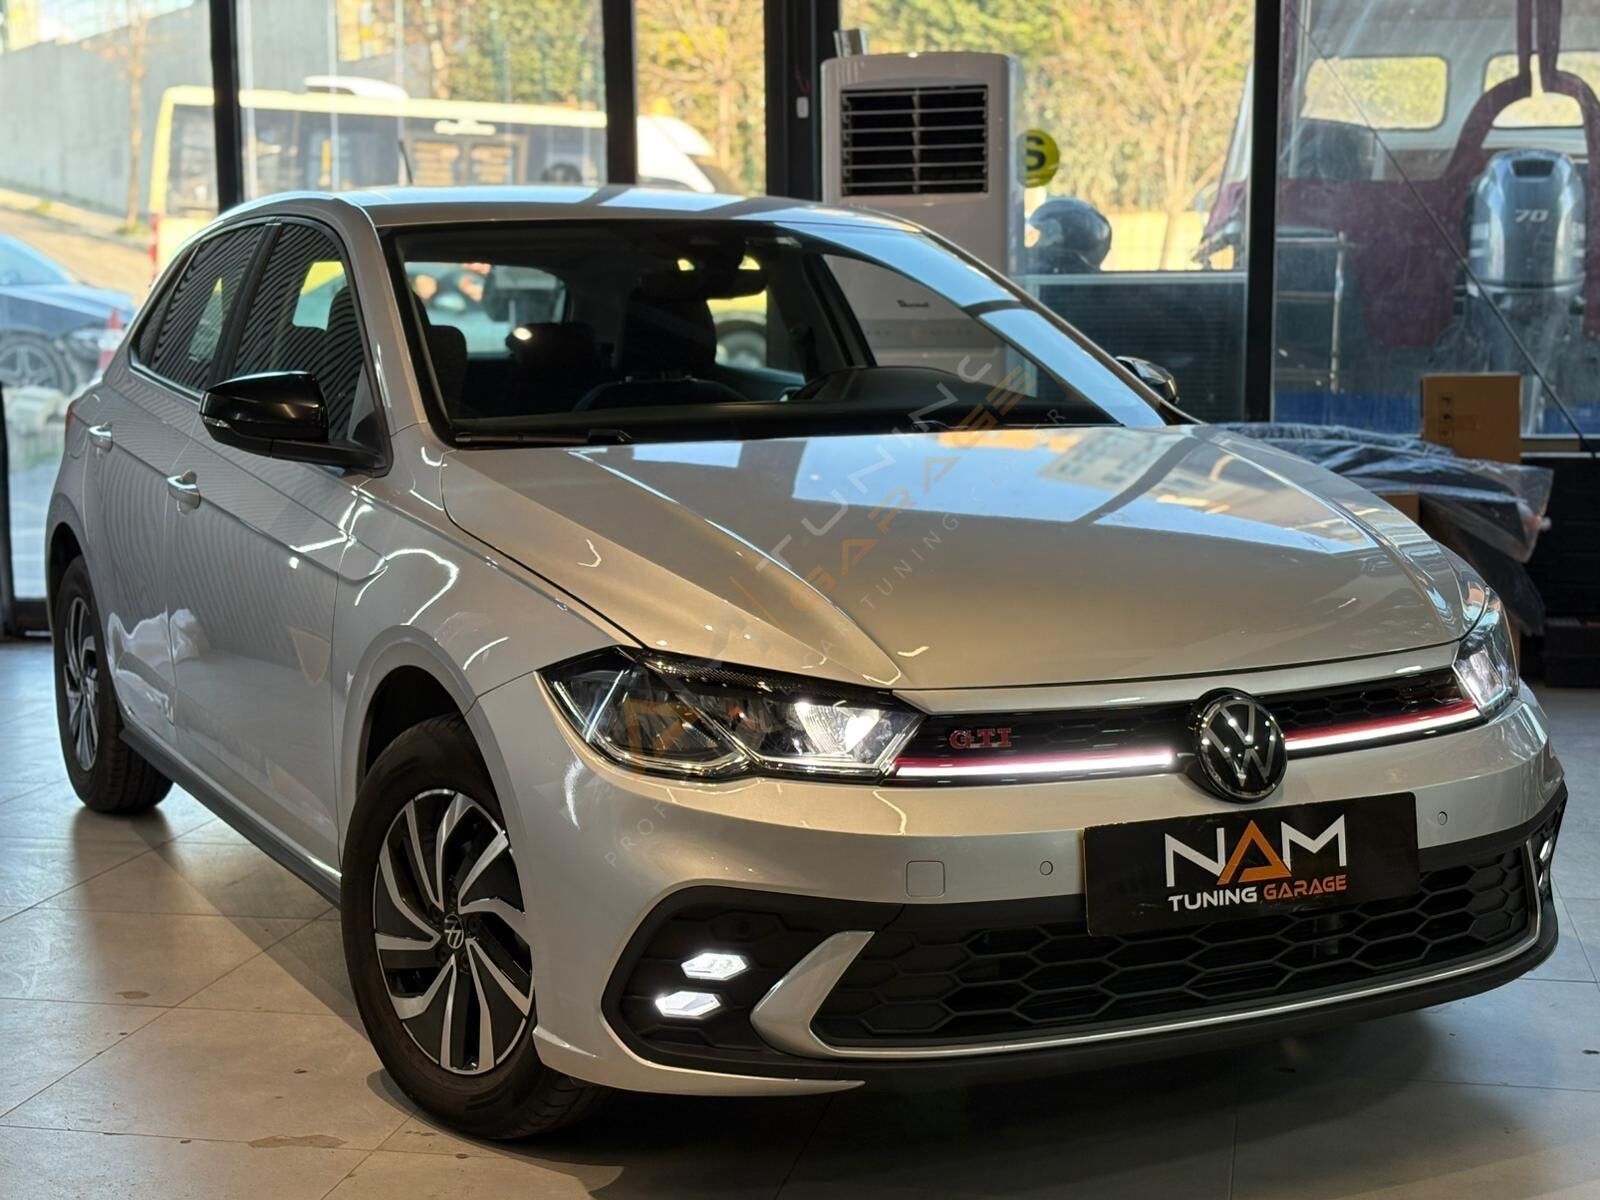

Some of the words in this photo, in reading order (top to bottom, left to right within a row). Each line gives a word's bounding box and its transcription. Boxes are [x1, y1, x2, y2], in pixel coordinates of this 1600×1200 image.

[1515, 209, 1549, 222] 70
[949, 728, 1012, 750] GTI
[1164, 814, 1348, 888] NAM
[1168, 886, 1257, 912] TUNING
[1263, 874, 1347, 900] GARAGE
